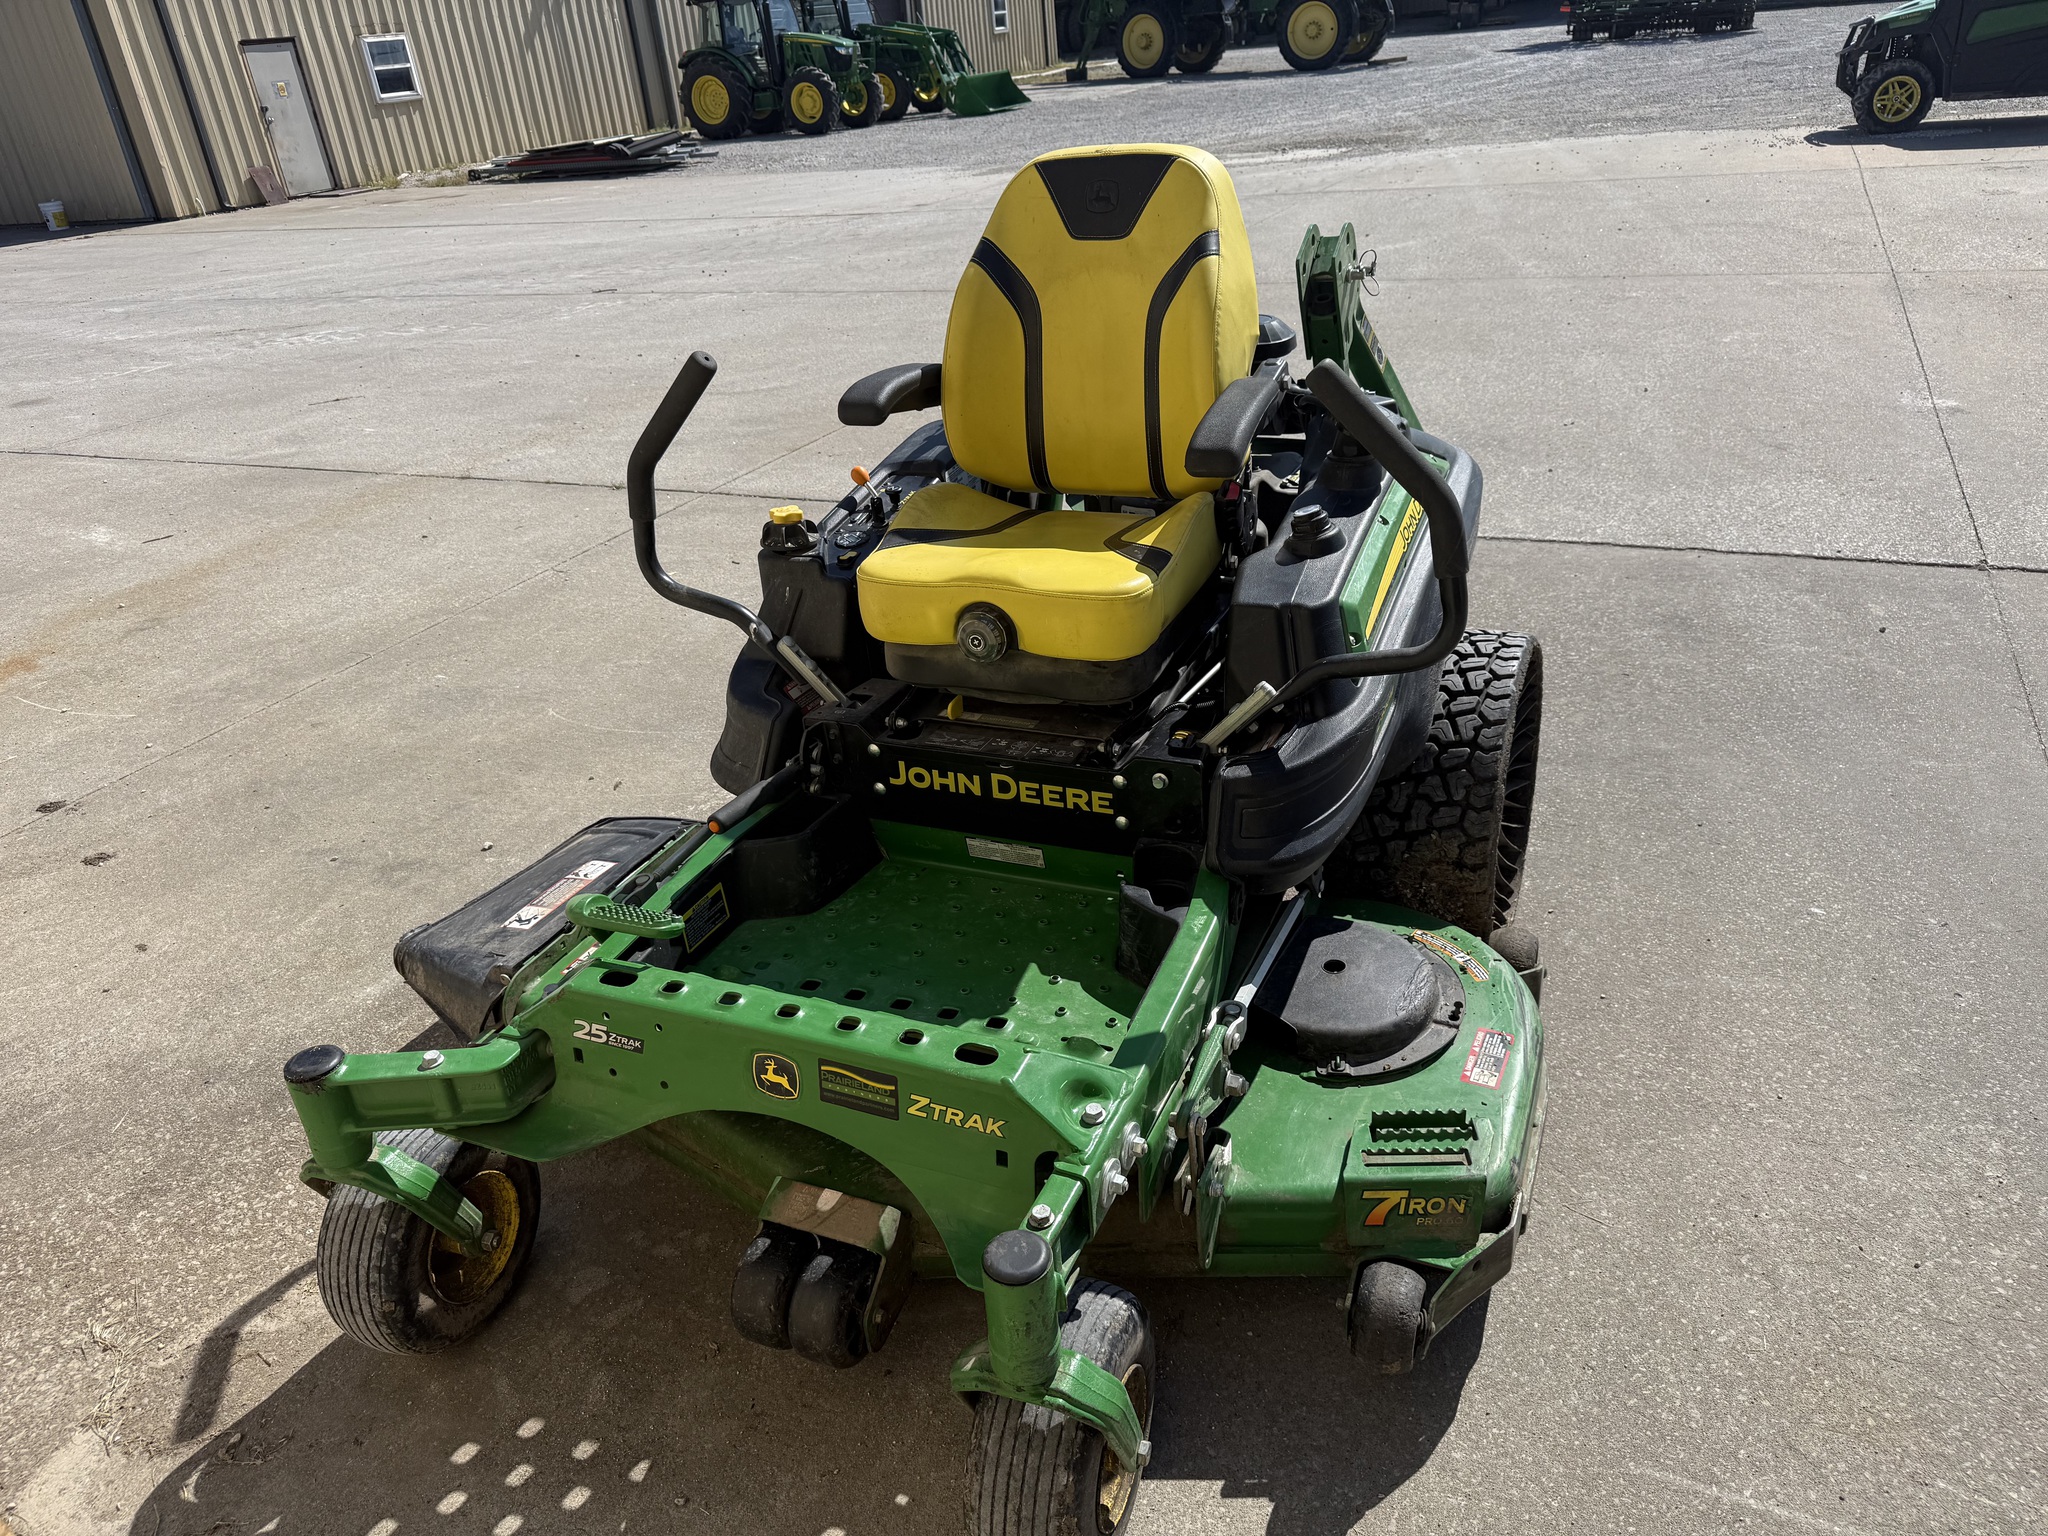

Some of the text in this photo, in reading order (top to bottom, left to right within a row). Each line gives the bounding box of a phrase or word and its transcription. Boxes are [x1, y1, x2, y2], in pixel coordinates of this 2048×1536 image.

[889, 760, 1115, 815] JOHN DEERE
[573, 1020, 641, 1048] 25 ZTRAK
[821, 1070, 891, 1096] PRAIRIELAND
[906, 1093, 1008, 1138] ZTRAK
